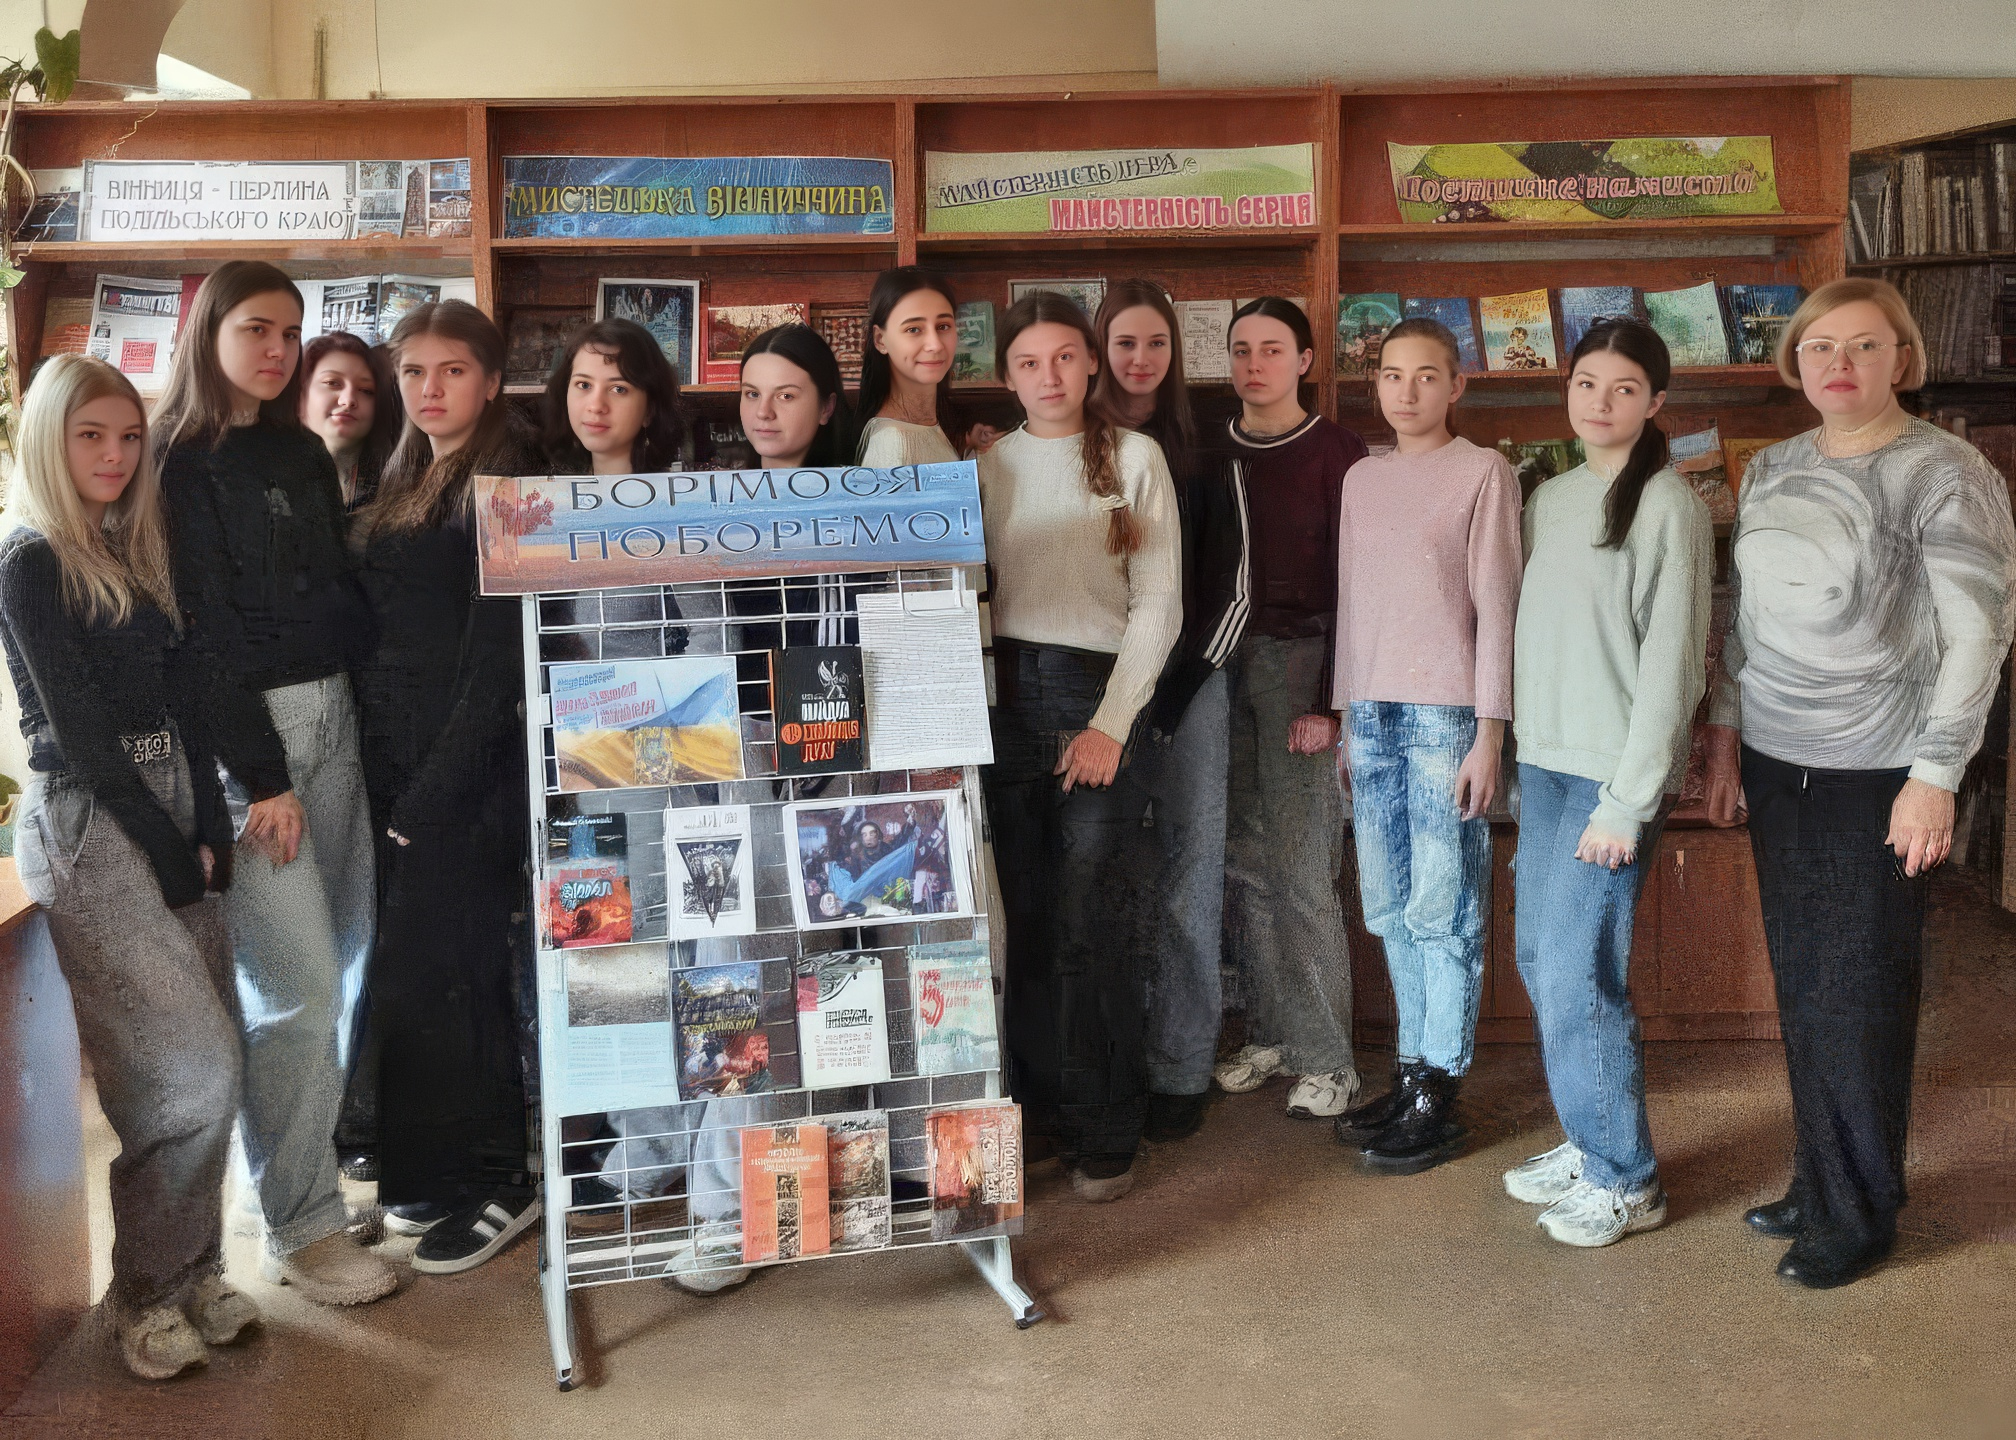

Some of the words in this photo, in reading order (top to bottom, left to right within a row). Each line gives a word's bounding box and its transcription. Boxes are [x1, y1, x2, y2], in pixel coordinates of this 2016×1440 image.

[107, 180, 203, 204] ВІННИЦЯ
[229, 180, 332, 201] ПЕРЛИНА
[101, 209, 269, 232] ПОДІЛЬСЬКОГО
[278, 210, 344, 231] КРАЮ
[571, 464, 922, 511] БОРІМОСЯ
[568, 506, 970, 562] ПОБОРЕМО!
